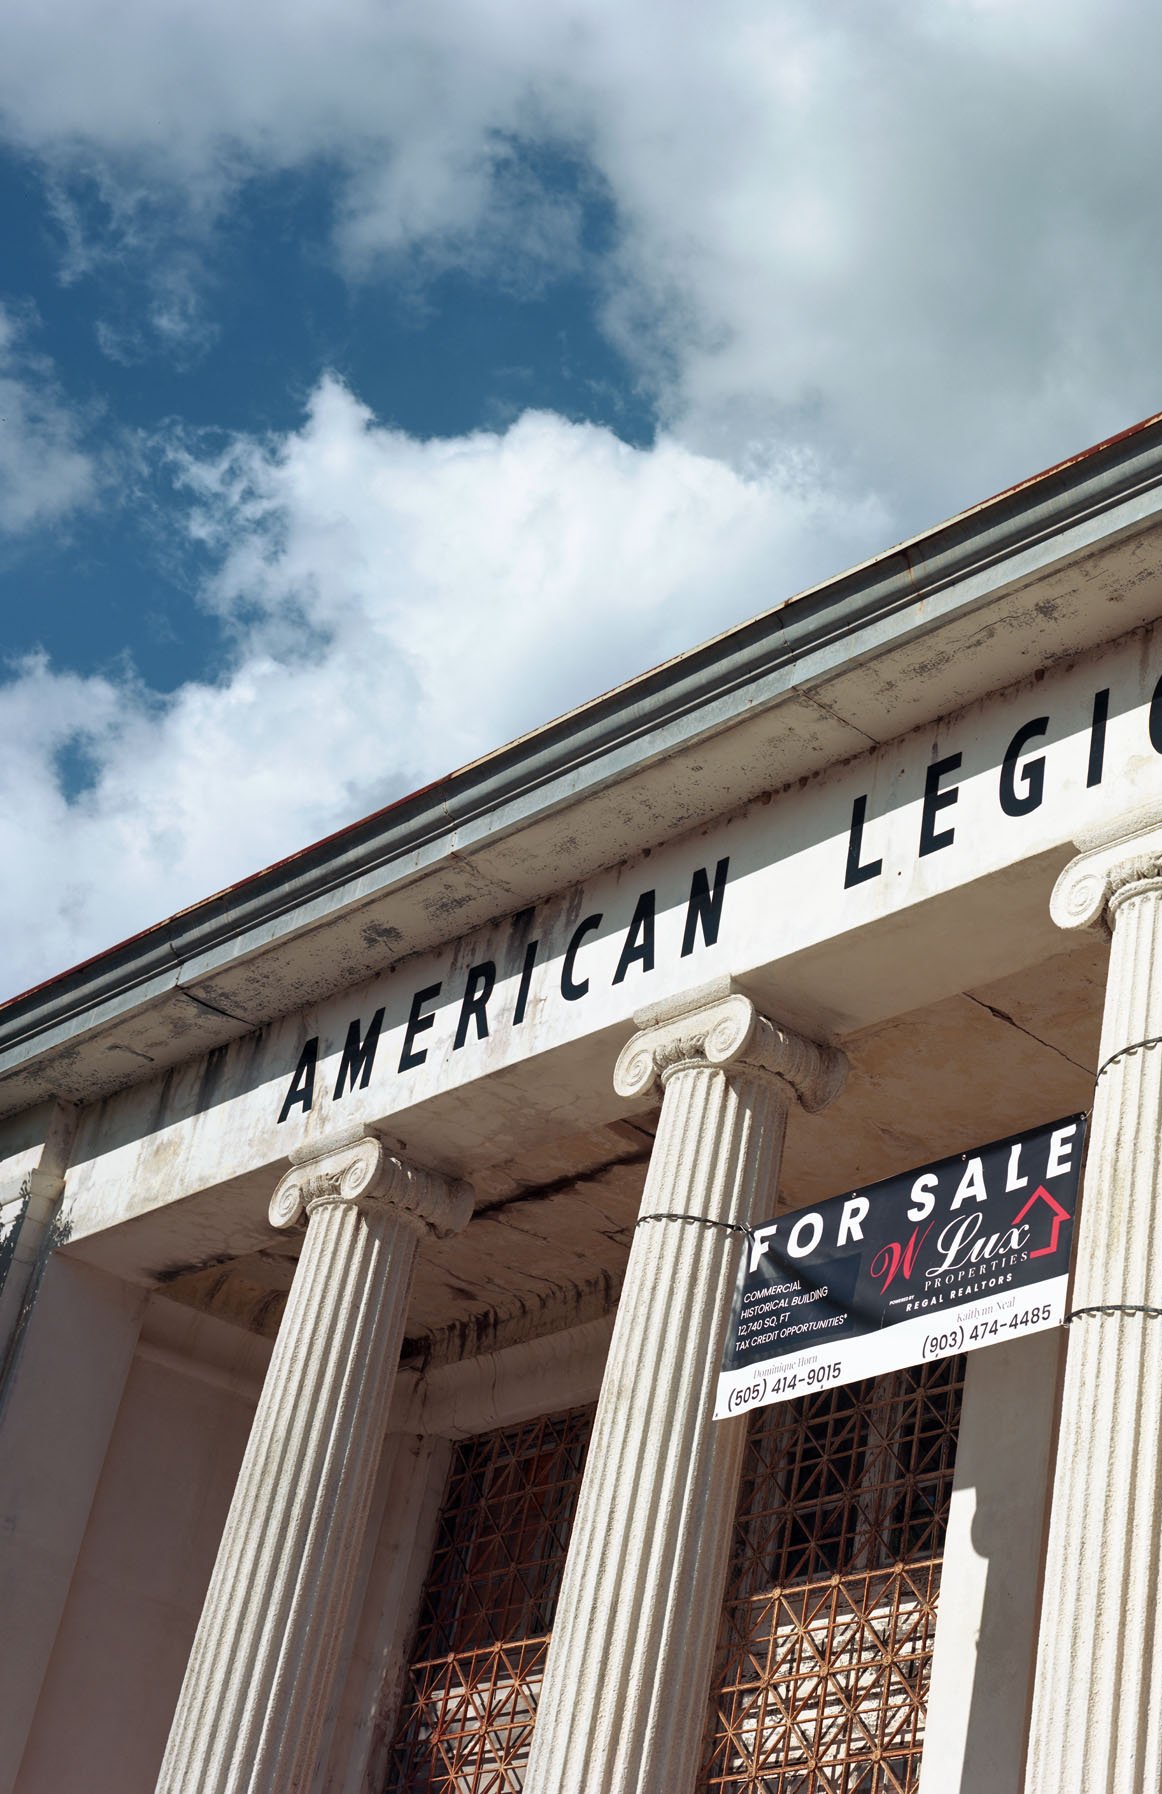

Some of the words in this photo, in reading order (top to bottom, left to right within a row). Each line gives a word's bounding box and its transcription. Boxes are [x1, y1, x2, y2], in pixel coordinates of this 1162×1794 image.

[277, 856, 730, 1124] AMERICAN
[749, 1197, 870, 1273] FOR
[907, 1124, 1077, 1222] SALE
[925, 1212, 1030, 1277] Lux
[924, 1251, 1028, 1291] PROPERTIES
[740, 1297, 789, 1319] HISTORICAL
[791, 1286, 828, 1306] BUILDING
[743, 1280, 802, 1303] COMMERCIAL
[906, 1294, 944, 1312] REGAL
[950, 1273, 1013, 1299] REALTORS
[738, 1319, 762, 1336] 12,740
[764, 1316, 778, 1328] SQ.
[780, 1312, 791, 1324] FT
[922, 1325, 965, 1358] (903)
[969, 1304, 1052, 1341] 474-4485
[956, 1304, 994, 1323] Kaitlynn
[735, 1339, 750, 1351] TAX
[750, 1331, 779, 1346] CREDIT
[753, 1361, 796, 1379] Dominique
[798, 1355, 818, 1368] Horn
[728, 1378, 767, 1412] (505)
[771, 1362, 842, 1394] 414-9015
